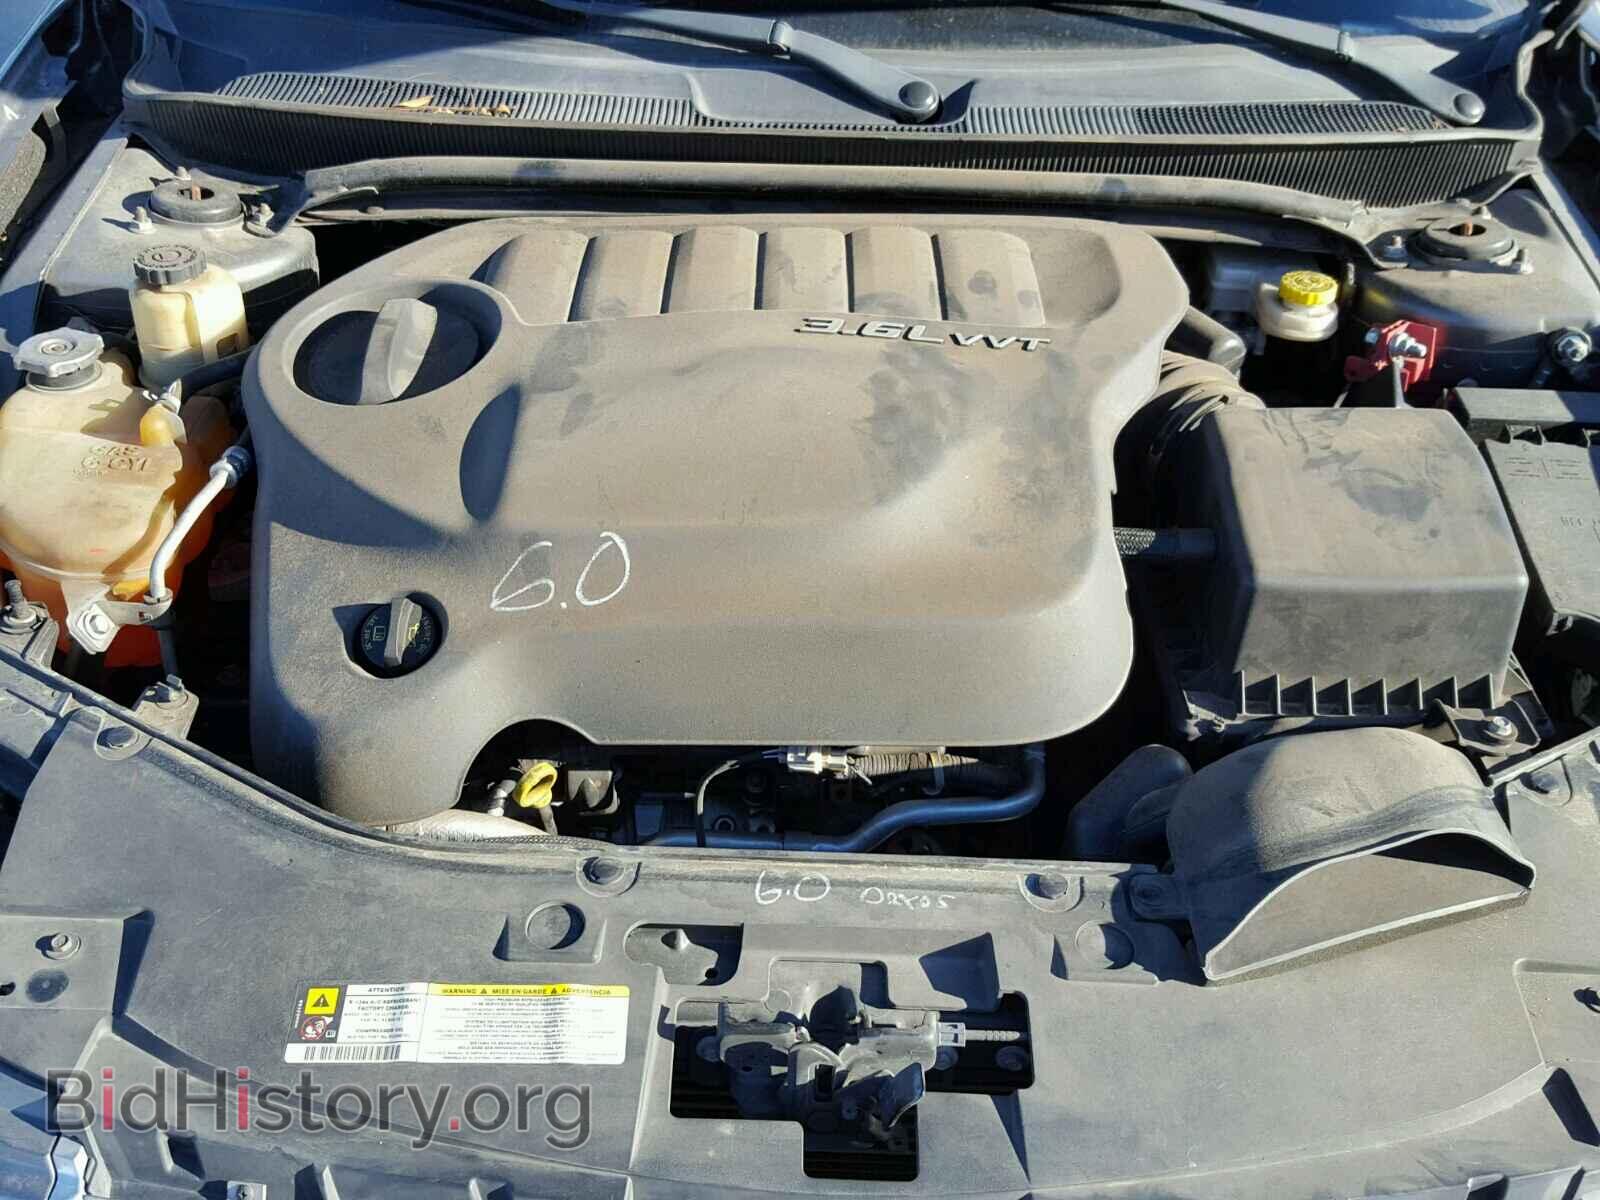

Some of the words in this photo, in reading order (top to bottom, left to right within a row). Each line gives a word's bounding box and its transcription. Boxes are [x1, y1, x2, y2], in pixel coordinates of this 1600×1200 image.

[796, 316, 945, 345] 3.6L
[949, 332, 1051, 351] VVT
[489, 531, 631, 612] 6.0
[754, 870, 832, 905] 6.0
